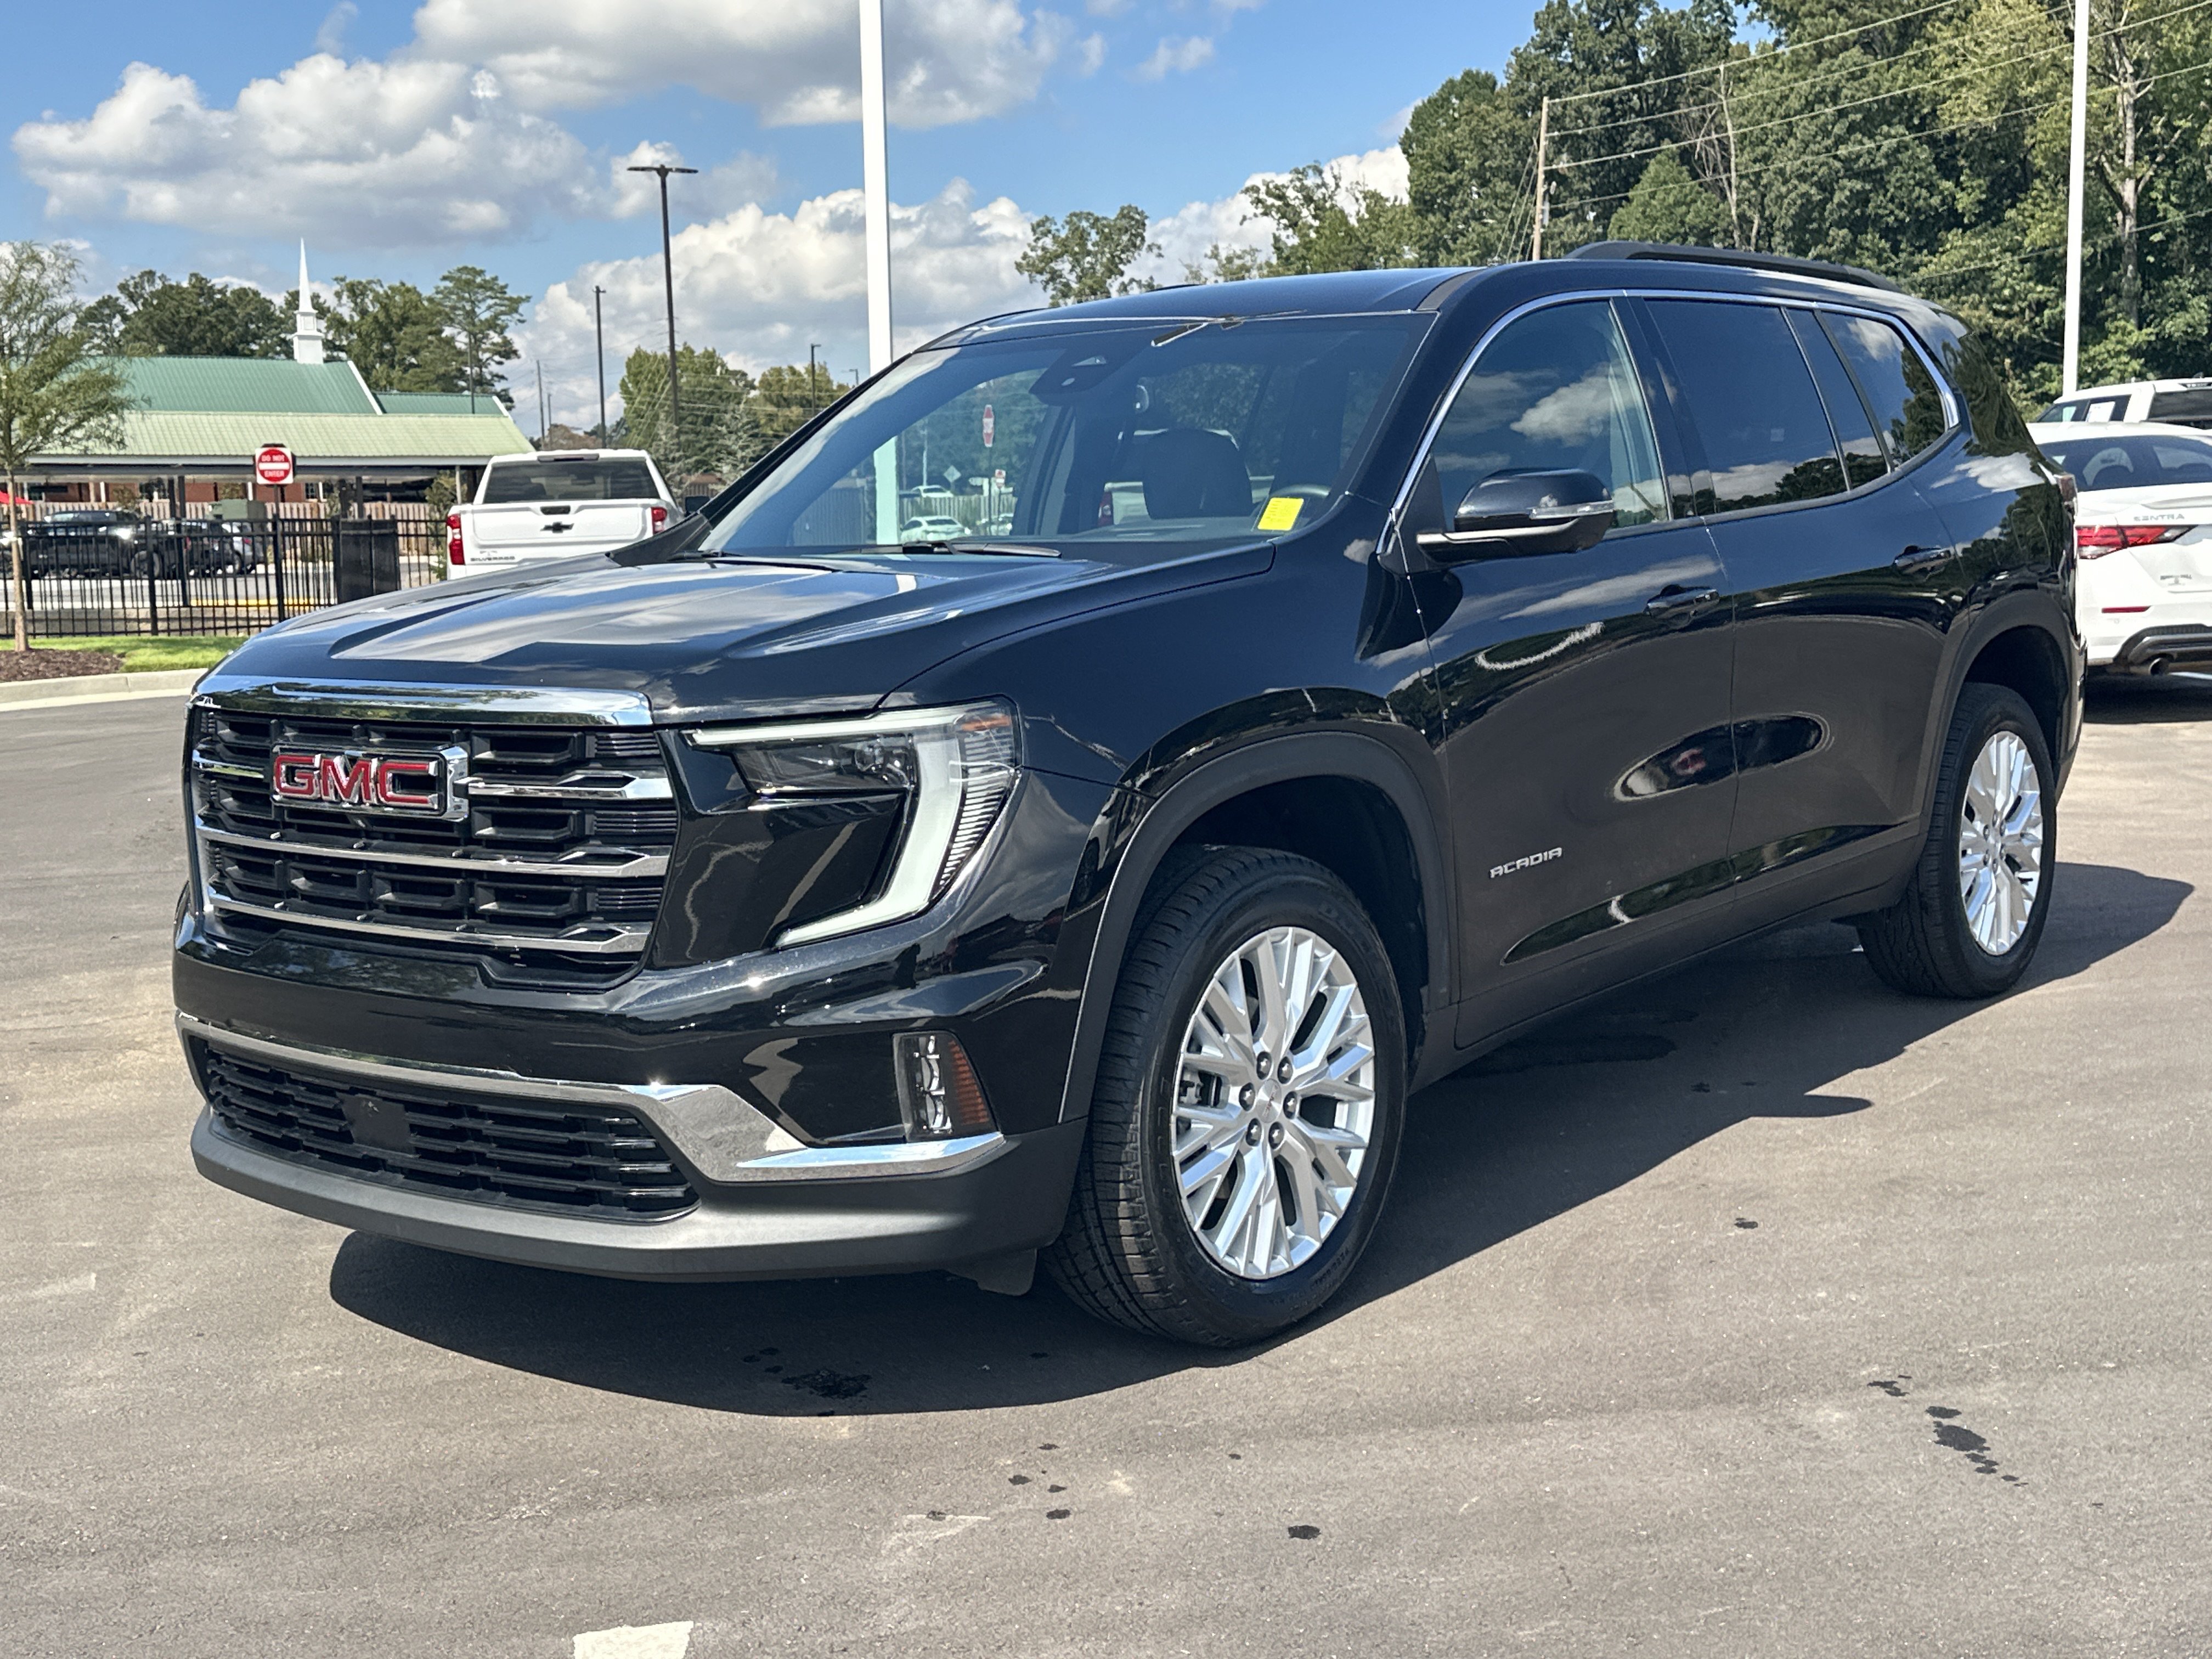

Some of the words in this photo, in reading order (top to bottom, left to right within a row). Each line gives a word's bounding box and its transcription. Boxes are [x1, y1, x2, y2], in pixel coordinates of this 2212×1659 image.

[2133, 514, 2185, 522] SENTRA
[274, 754, 439, 810] GMC
[1490, 847, 1562, 878] ACADIA
